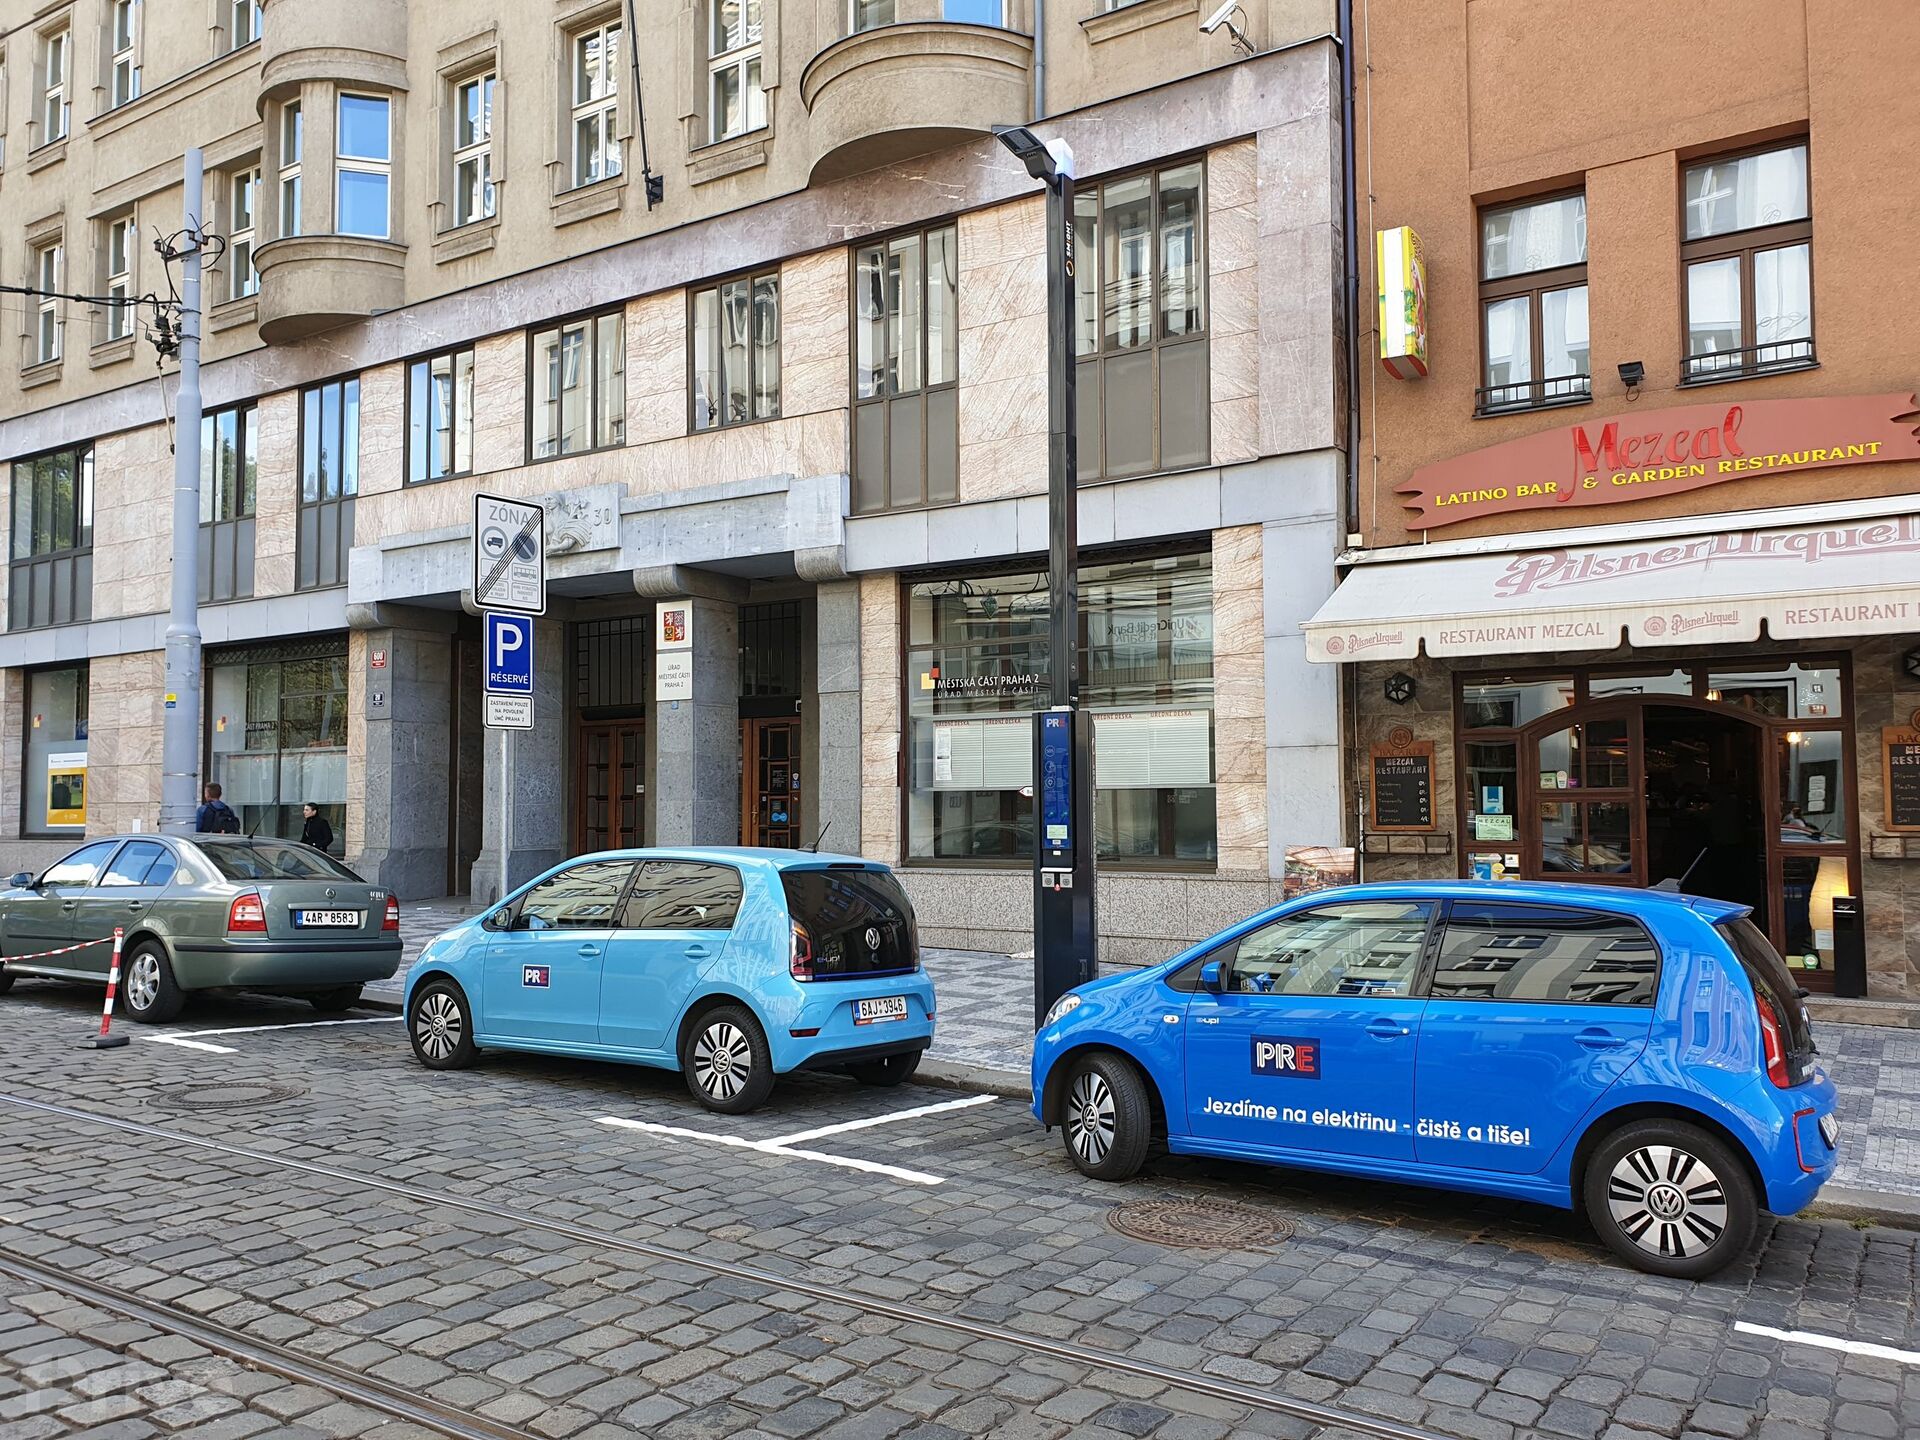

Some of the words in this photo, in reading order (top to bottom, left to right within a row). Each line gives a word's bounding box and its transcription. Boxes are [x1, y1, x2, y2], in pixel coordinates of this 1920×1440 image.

[1557, 405, 1744, 502] Mezcal
[1435, 487, 1508, 507] LATINO
[1516, 481, 1558, 497] BAR
[1582, 476, 1599, 489] &
[1611, 463, 1705, 486] GARDEN
[1718, 441, 1882, 473] RESTAURANT
[489, 504, 530, 526] ZÓNA
[1494, 537, 1711, 598] Pilsner
[1671, 613, 1707, 636] Pilsner
[1704, 610, 1739, 626] Urquell
[1785, 602, 1909, 625] RESTAURANT
[496, 622, 523, 667] P
[1348, 633, 1376, 653] Pilsner
[1375, 631, 1403, 646] Urquell
[1439, 625, 1537, 645] RESTAURANT
[1542, 622, 1604, 639] MEZCAL
[490, 671, 529, 684] RÉSERVÉ
[937, 675, 976, 689] MĚSTSKÁ
[977, 674, 999, 687] ČÁST
[1001, 673, 1032, 685] PRAHA
[1034, 673, 1039, 683] 2
[1376, 766, 1428, 775] RESTAURANT
[1386, 758, 1415, 766] MEZCAL
[305, 912, 323, 923] 4AR
[330, 912, 354, 923] 8583
[525, 968, 548, 984] PRE
[861, 1000, 878, 1017] 6AJ
[884, 998, 903, 1014] 3946
[1256, 1041, 1315, 1072] PRE
[1203, 1096, 1278, 1119] Jezdíme
[1283, 1108, 1307, 1122] na
[1311, 1108, 1397, 1132] elektřinu
[1417, 1118, 1462, 1138] čistě
[1467, 1126, 1482, 1142] a
[1487, 1124, 1530, 1146] tiše!
